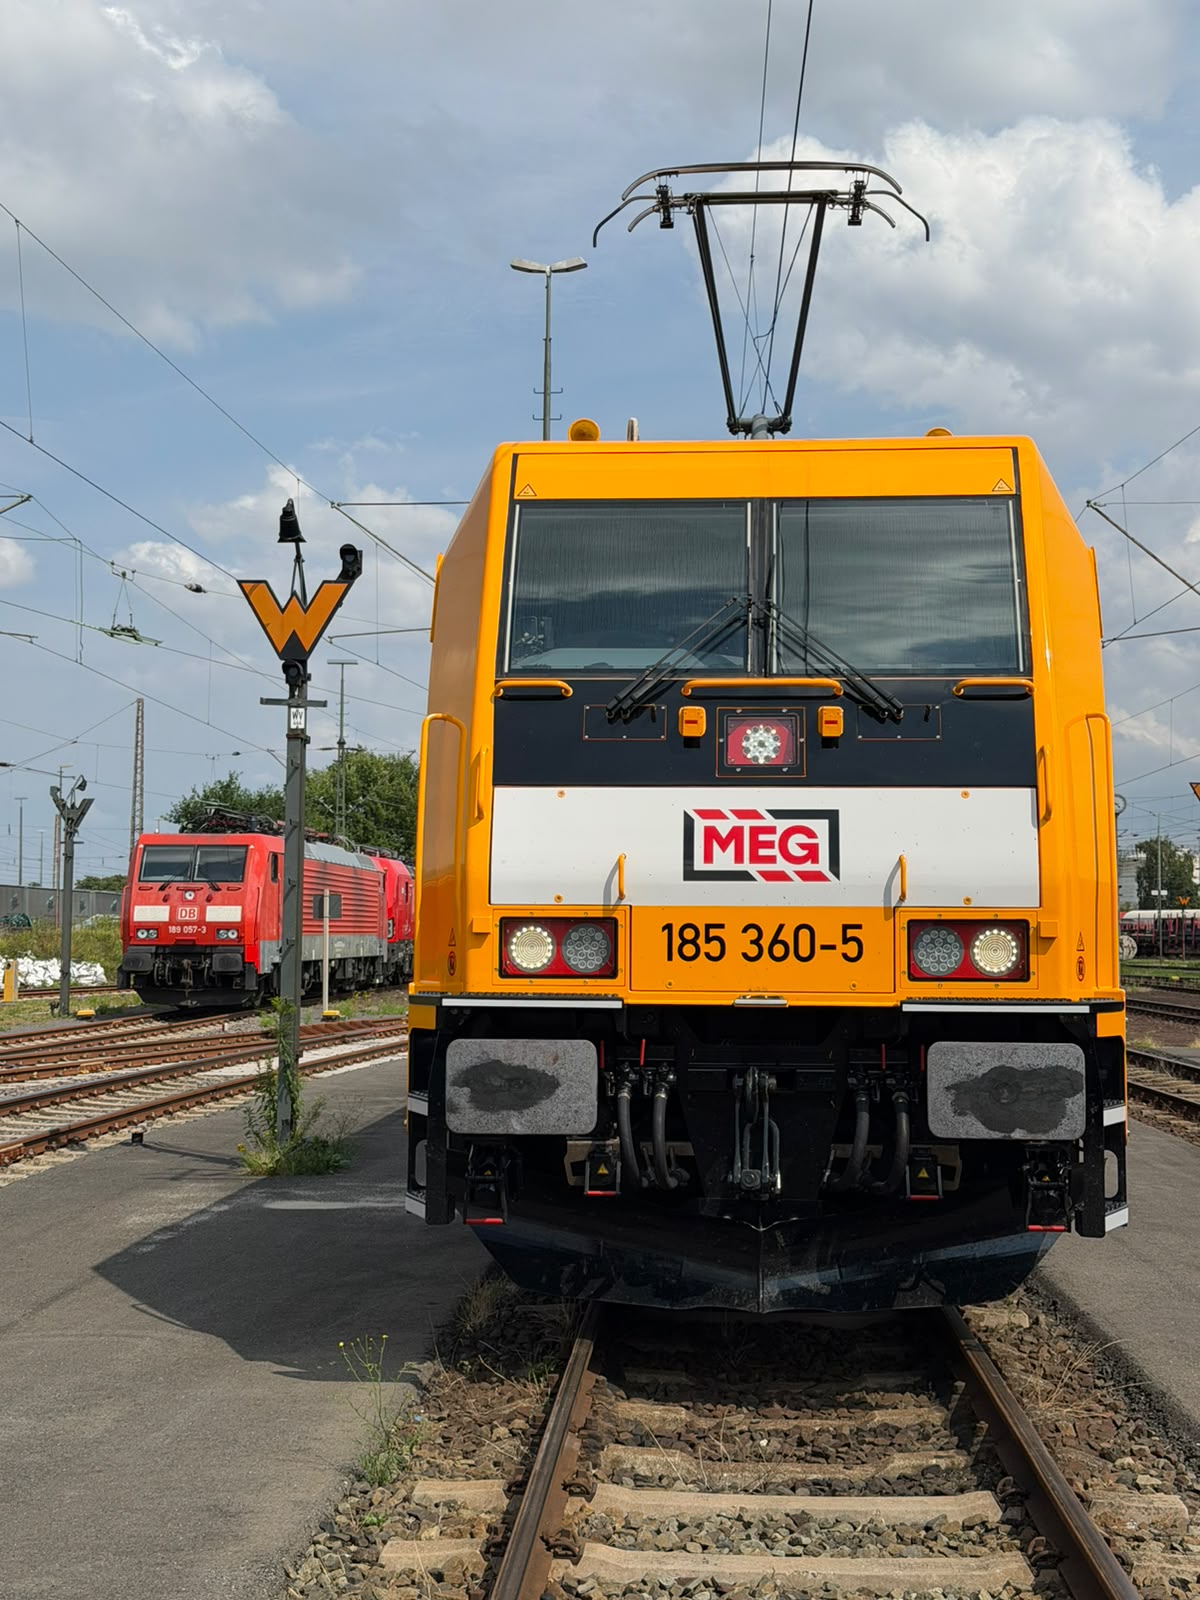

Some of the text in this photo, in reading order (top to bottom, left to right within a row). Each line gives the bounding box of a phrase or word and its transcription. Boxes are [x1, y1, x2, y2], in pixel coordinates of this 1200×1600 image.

[238, 580, 352, 658] W
[703, 825, 820, 865] MEG
[168, 925, 207, 934] 189 057-3
[180, 908, 196, 919] DB
[662, 923, 864, 963] 185 360-5
